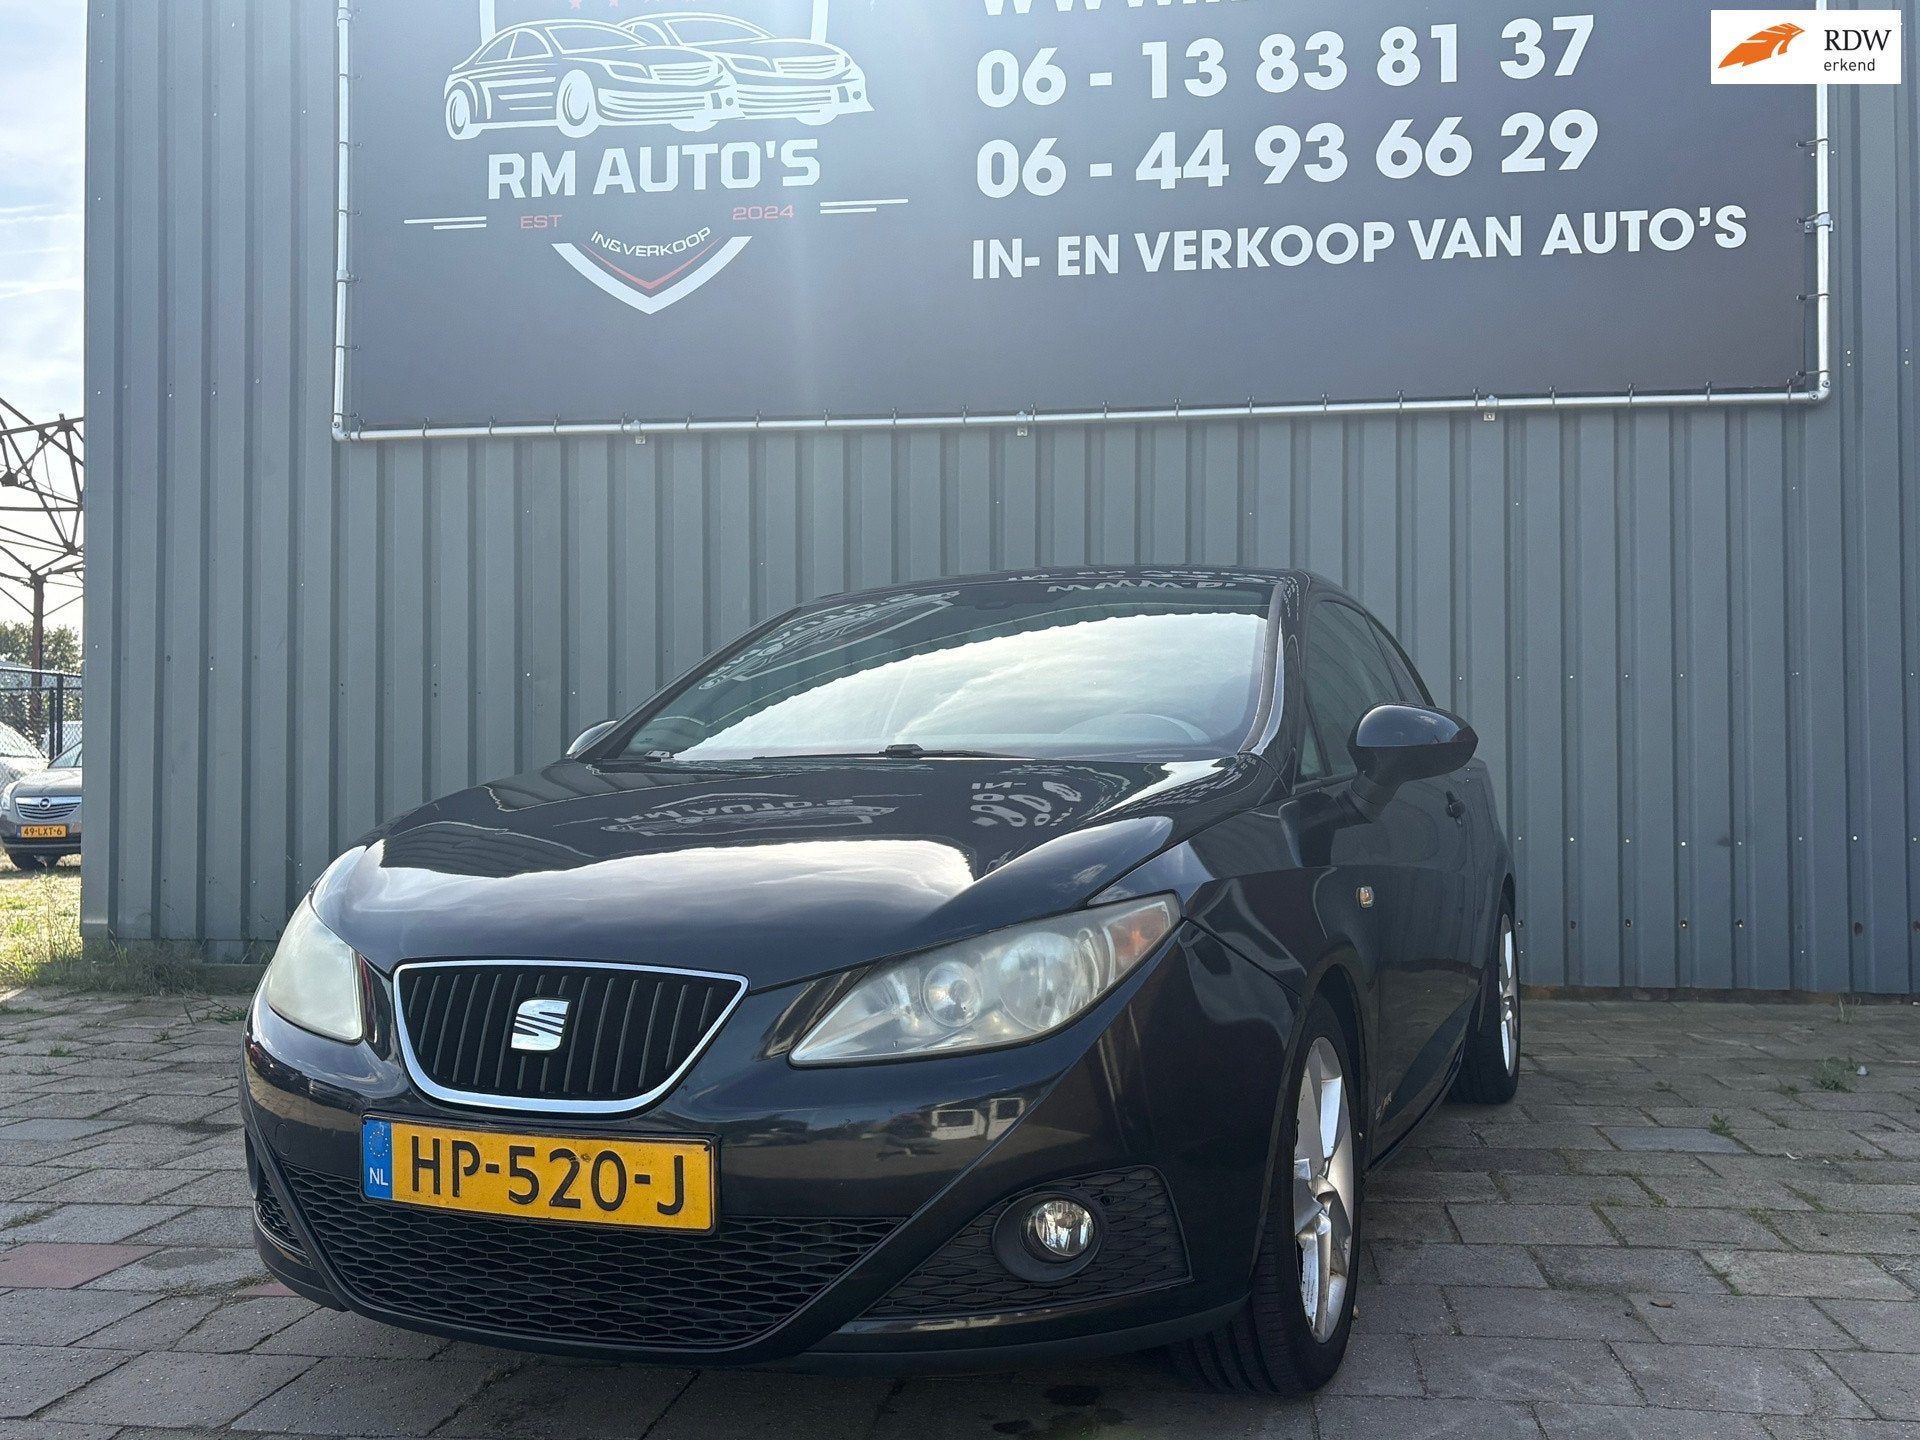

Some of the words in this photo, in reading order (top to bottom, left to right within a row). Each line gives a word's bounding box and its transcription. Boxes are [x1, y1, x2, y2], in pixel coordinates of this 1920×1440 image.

[976, 47, 1067, 108] 06
[1142, 37, 1228, 99] 13
[1255, 30, 1348, 93] 83
[1376, 23, 1458, 87] 81
[1499, 14, 1595, 80] 37
[487, 150, 577, 200] RM
[593, 138, 821, 195] AUTO'S
[976, 137, 1067, 199] 06
[1135, 128, 1230, 190] 44
[1254, 122, 1348, 183] 93
[1375, 116, 1473, 179] 66
[1500, 108, 1599, 174] 29
[520, 214, 563, 229] EST
[732, 204, 795, 221] 2024
[972, 238, 1040, 280] IN-
[1057, 233, 1119, 277] EN
[1133, 221, 1396, 273] VERKOOP
[1407, 215, 1523, 260] VAN
[369, 1166, 389, 1187] NL
[411, 1135, 685, 1217] HP-520-J
